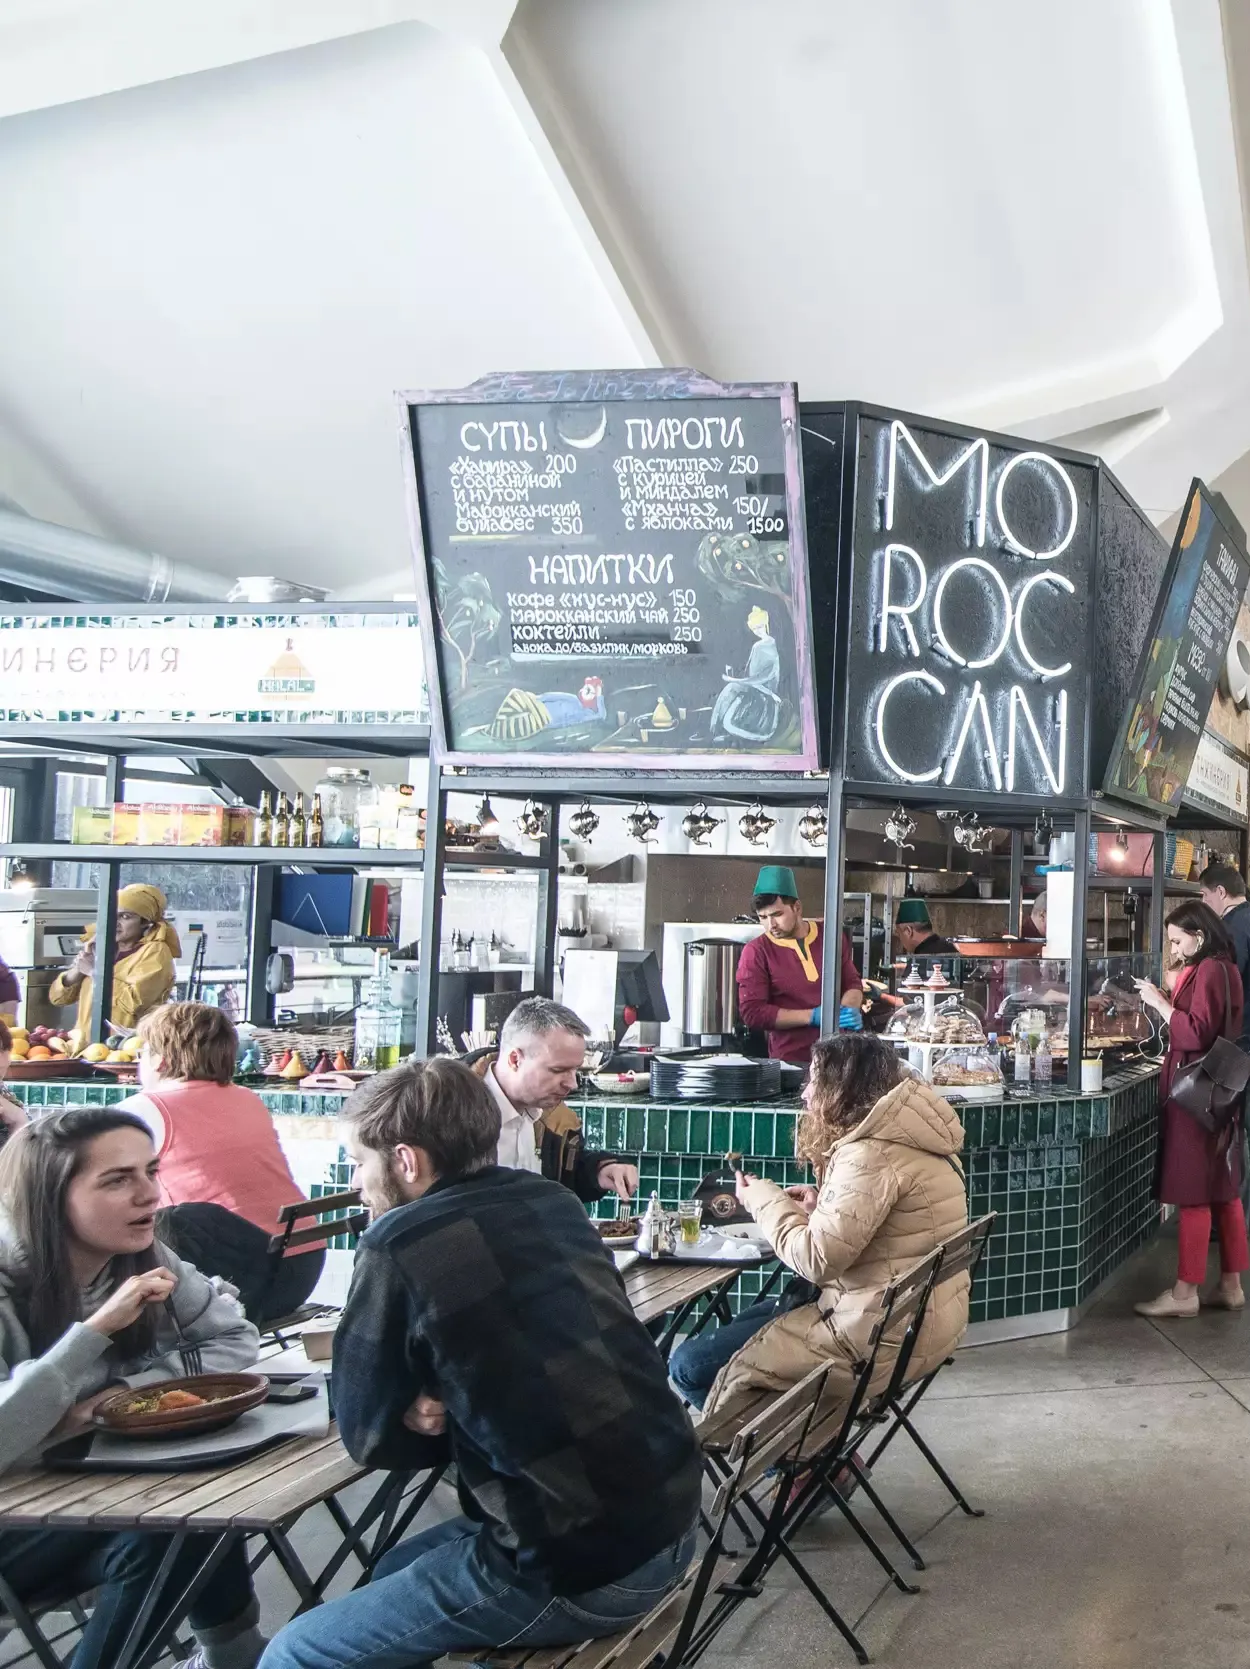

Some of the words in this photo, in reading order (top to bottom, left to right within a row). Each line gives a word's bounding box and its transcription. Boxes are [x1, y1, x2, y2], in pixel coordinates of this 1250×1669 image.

[460, 420, 548, 452] СУПЫ
[625, 416, 745, 450] ПИРОГИ
[545, 453, 577, 475] 200
[729, 455, 759, 474] 250
[633, 470, 707, 489] курицей
[469, 487, 530, 506] нутом
[636, 484, 729, 502] миндалем
[886, 420, 1078, 559] MO
[732, 496, 769, 518] 150/
[551, 516, 583, 535] 350
[641, 516, 733, 531] яблоками
[746, 517, 784, 534] 1500
[528, 554, 674, 585] НАПИТКИ
[668, 588, 697, 607] 150
[672, 607, 700, 624] 250
[880, 543, 1075, 677] ROC
[673, 625, 702, 642] 250
[877, 670, 1067, 794] CAN
